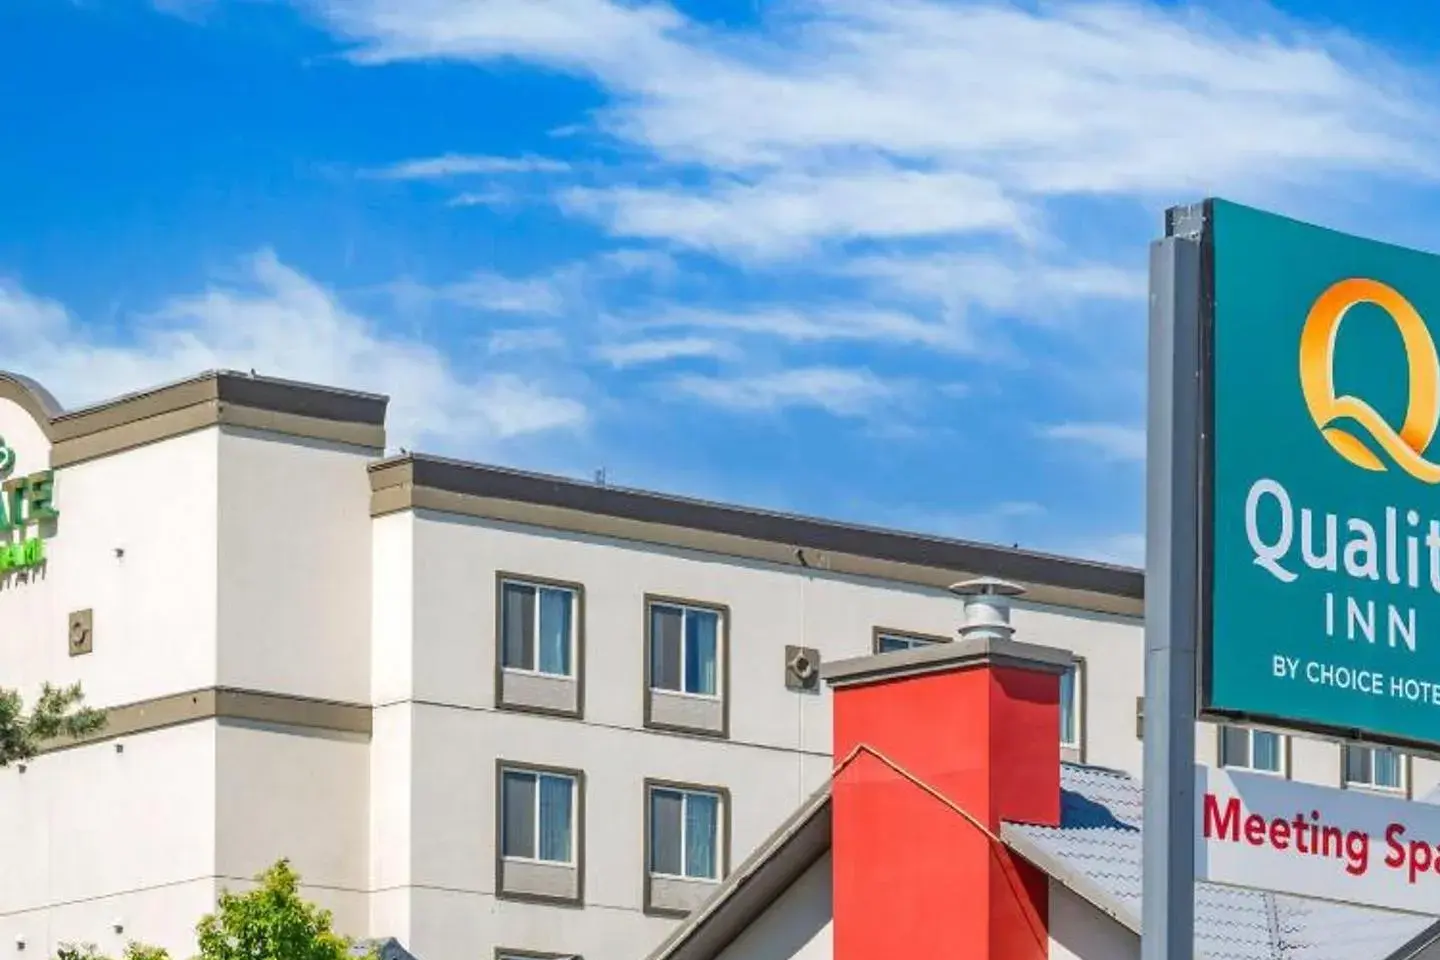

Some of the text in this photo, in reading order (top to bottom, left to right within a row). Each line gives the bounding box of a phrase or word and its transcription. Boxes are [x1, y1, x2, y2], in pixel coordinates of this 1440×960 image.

[1326, 593, 1416, 651] INN
[1273, 655, 1299, 680] BY
[1306, 661, 1383, 694] CHOICE
[1203, 792, 1369, 876] Meeting
